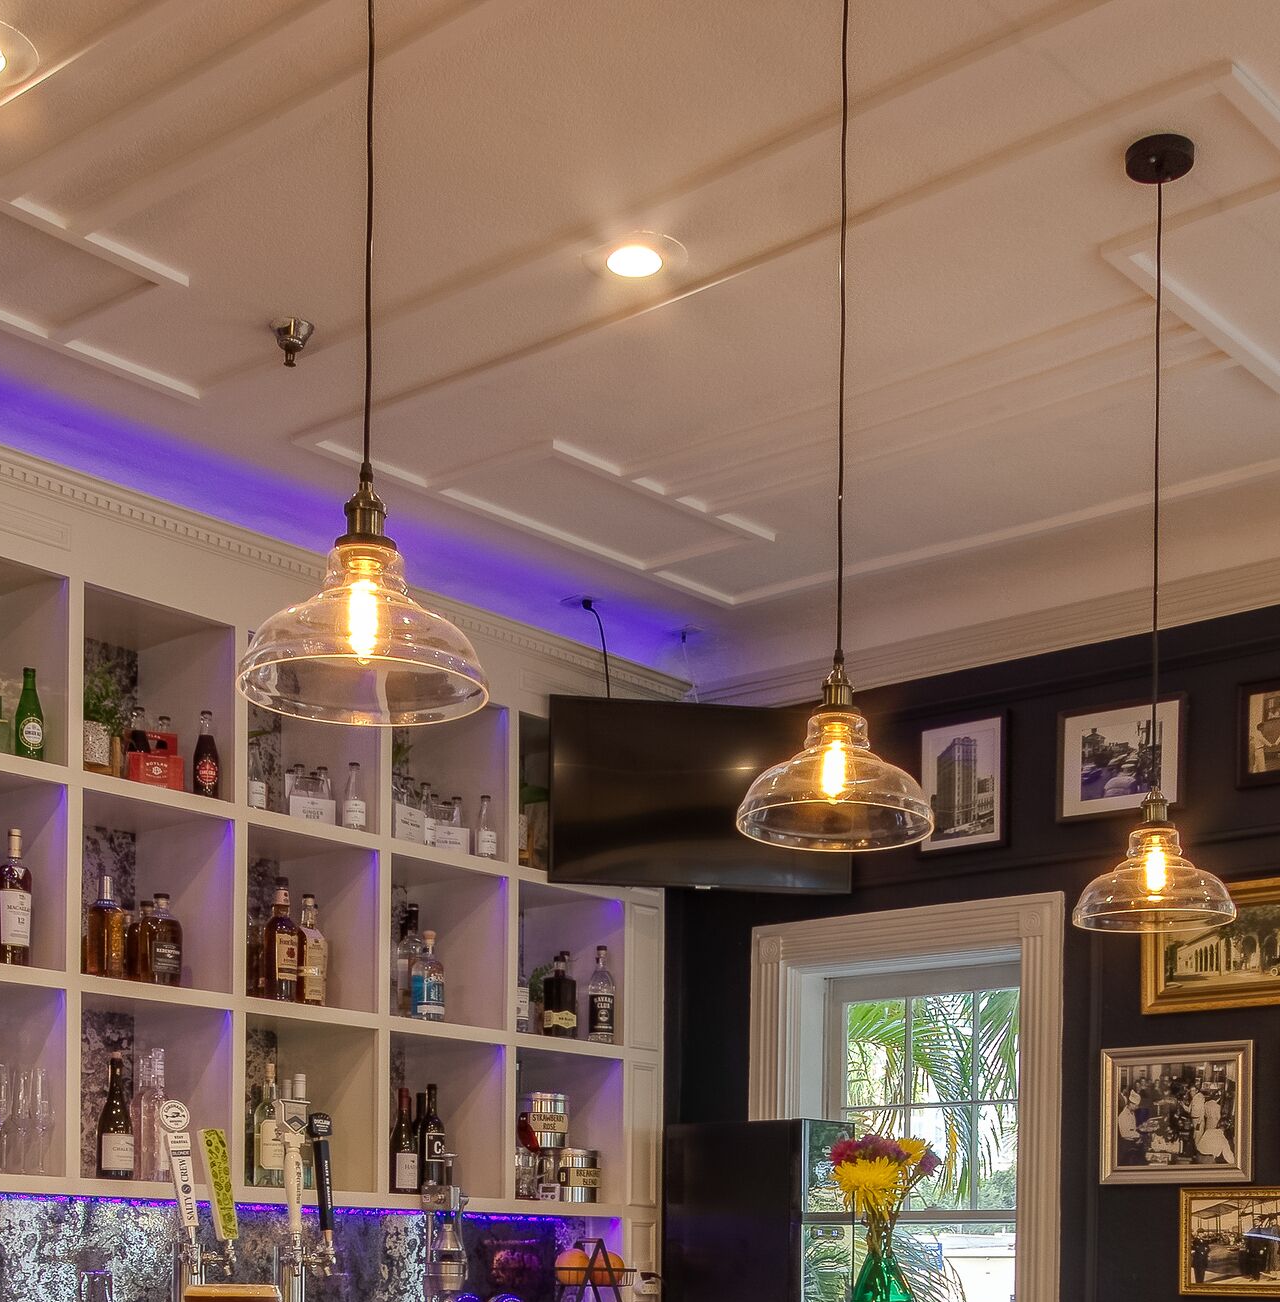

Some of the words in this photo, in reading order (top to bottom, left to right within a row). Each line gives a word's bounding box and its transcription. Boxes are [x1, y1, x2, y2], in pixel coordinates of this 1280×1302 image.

[17, 917, 25, 925] 12
[532, 1113, 564, 1122] STRAWBERRY
[178, 1159, 189, 1182] CREW
[582, 1178, 597, 1186] BLEND
[184, 1196, 195, 1221] SALTY
